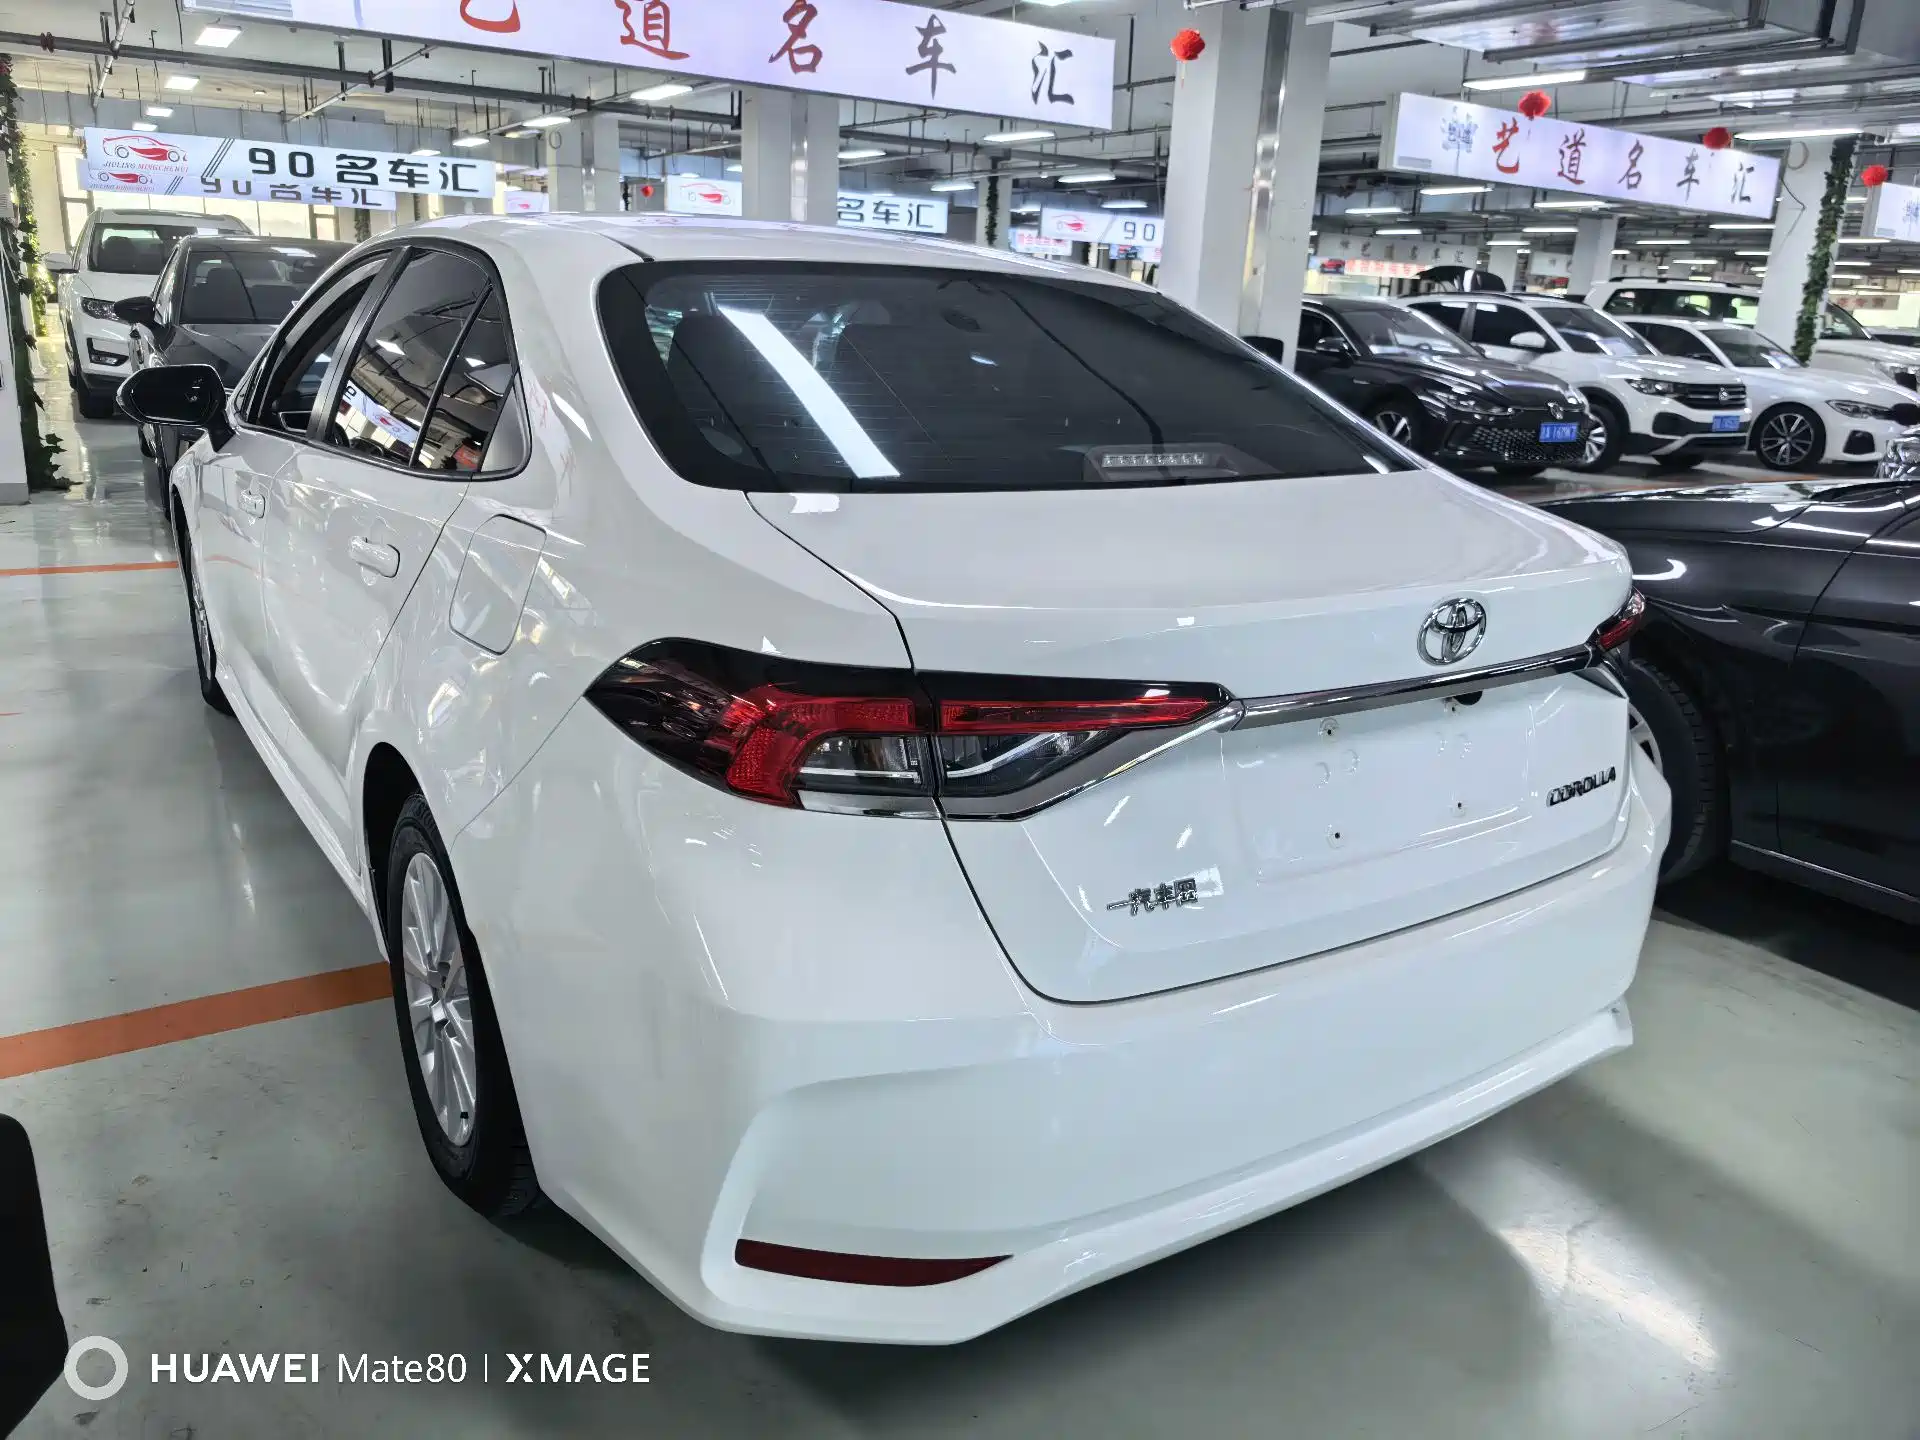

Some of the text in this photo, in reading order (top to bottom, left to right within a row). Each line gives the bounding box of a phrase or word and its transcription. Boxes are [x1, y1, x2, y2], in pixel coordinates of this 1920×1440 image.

[248, 147, 480, 193] 90 名车汇
[1492, 117, 1753, 204] 艺道名车汇
[837, 197, 935, 228] 名车汇
[1123, 221, 1156, 242] 90
[1546, 766, 1616, 808] COROLLA
